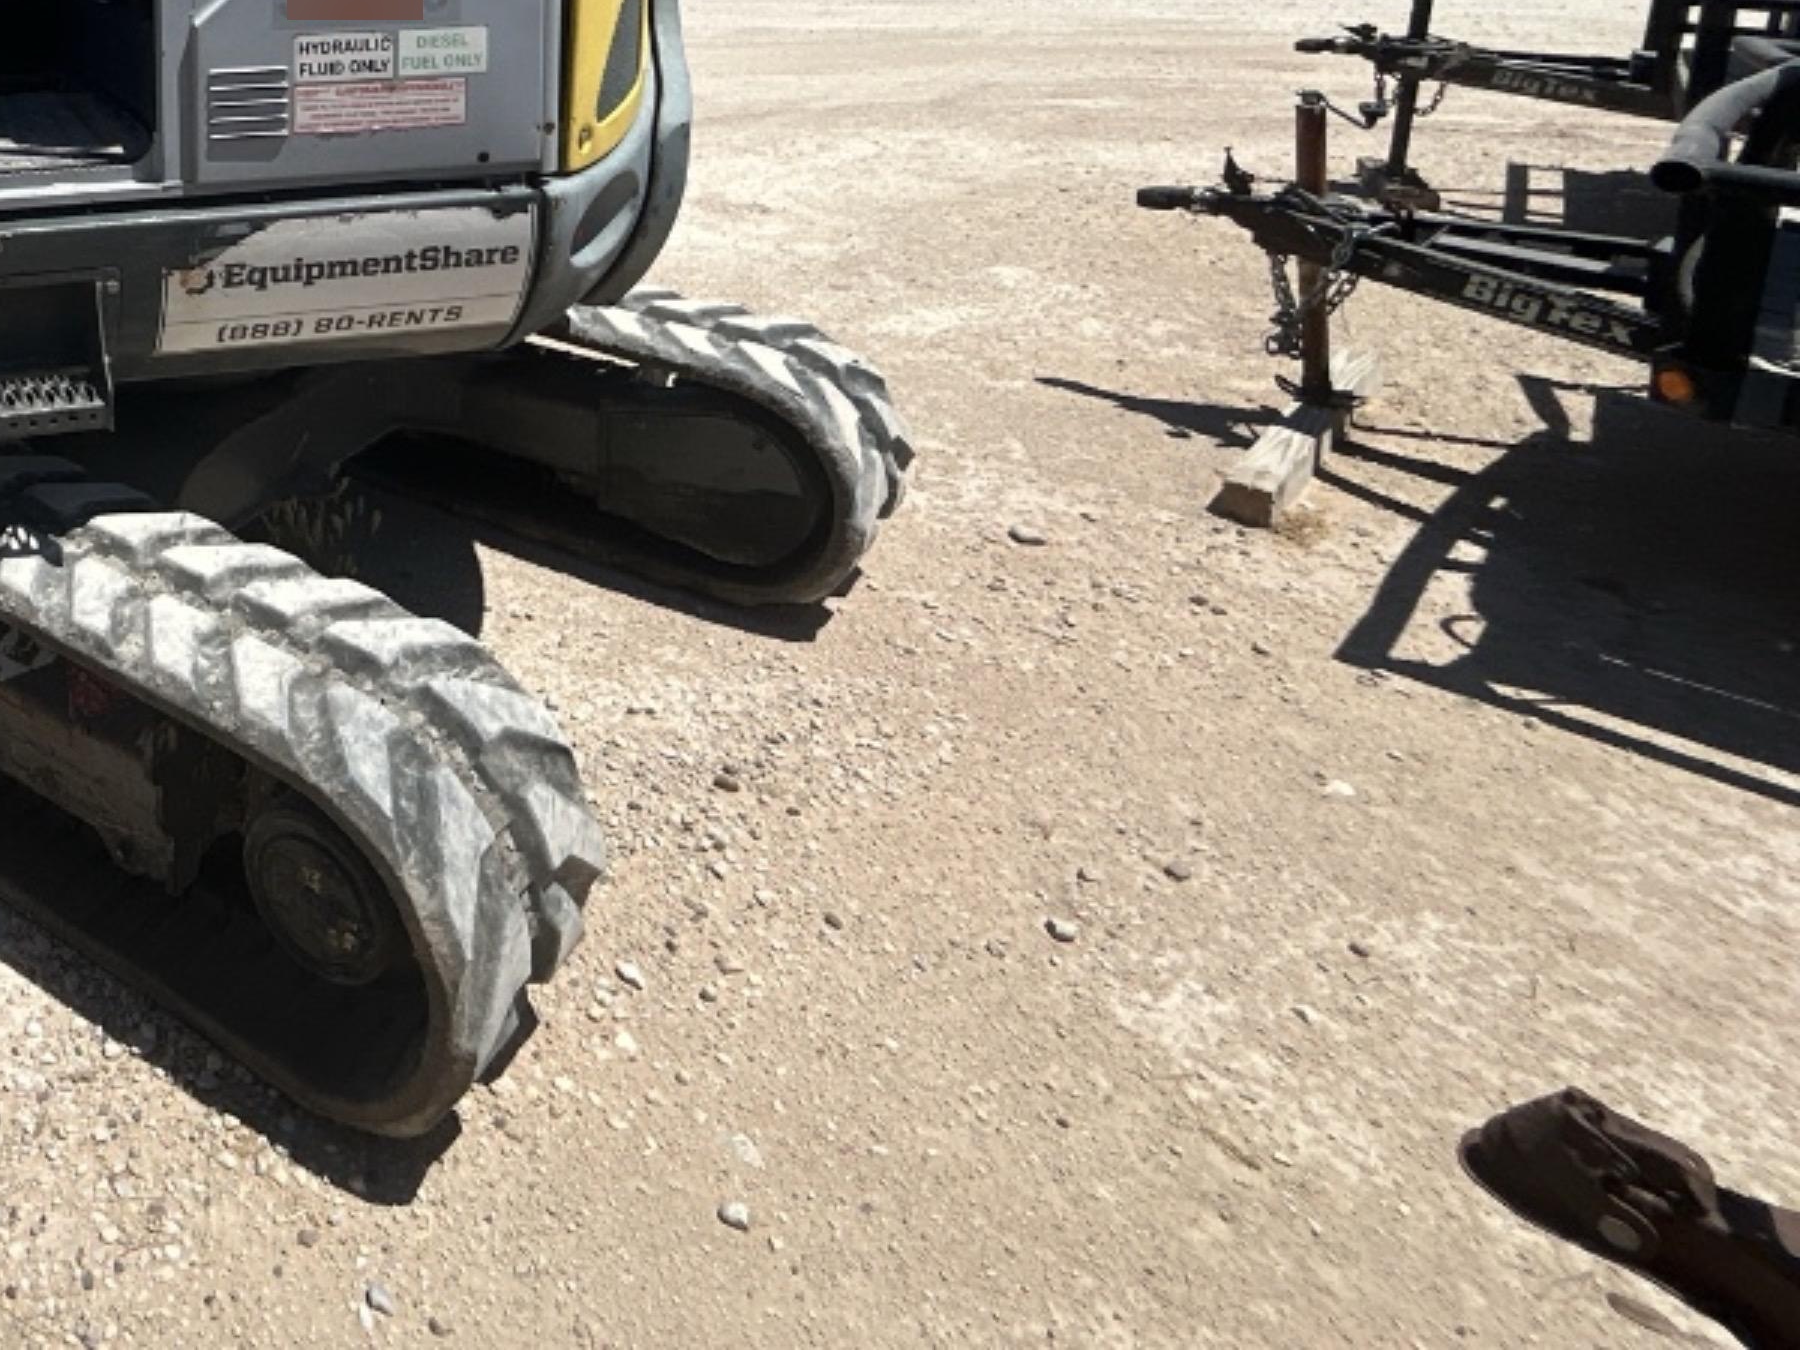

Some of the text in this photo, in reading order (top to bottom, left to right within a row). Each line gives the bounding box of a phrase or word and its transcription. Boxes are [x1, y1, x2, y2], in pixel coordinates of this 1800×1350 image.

[299, 36, 392, 56] HYDRAULIC
[416, 32, 469, 49] DIESEL
[299, 58, 391, 77] FLUID ONLY
[402, 52, 483, 71] FUEL ONLY
[222, 245, 520, 291] EquipmentShare
[215, 305, 464, 343] (888) 80-RENTS
